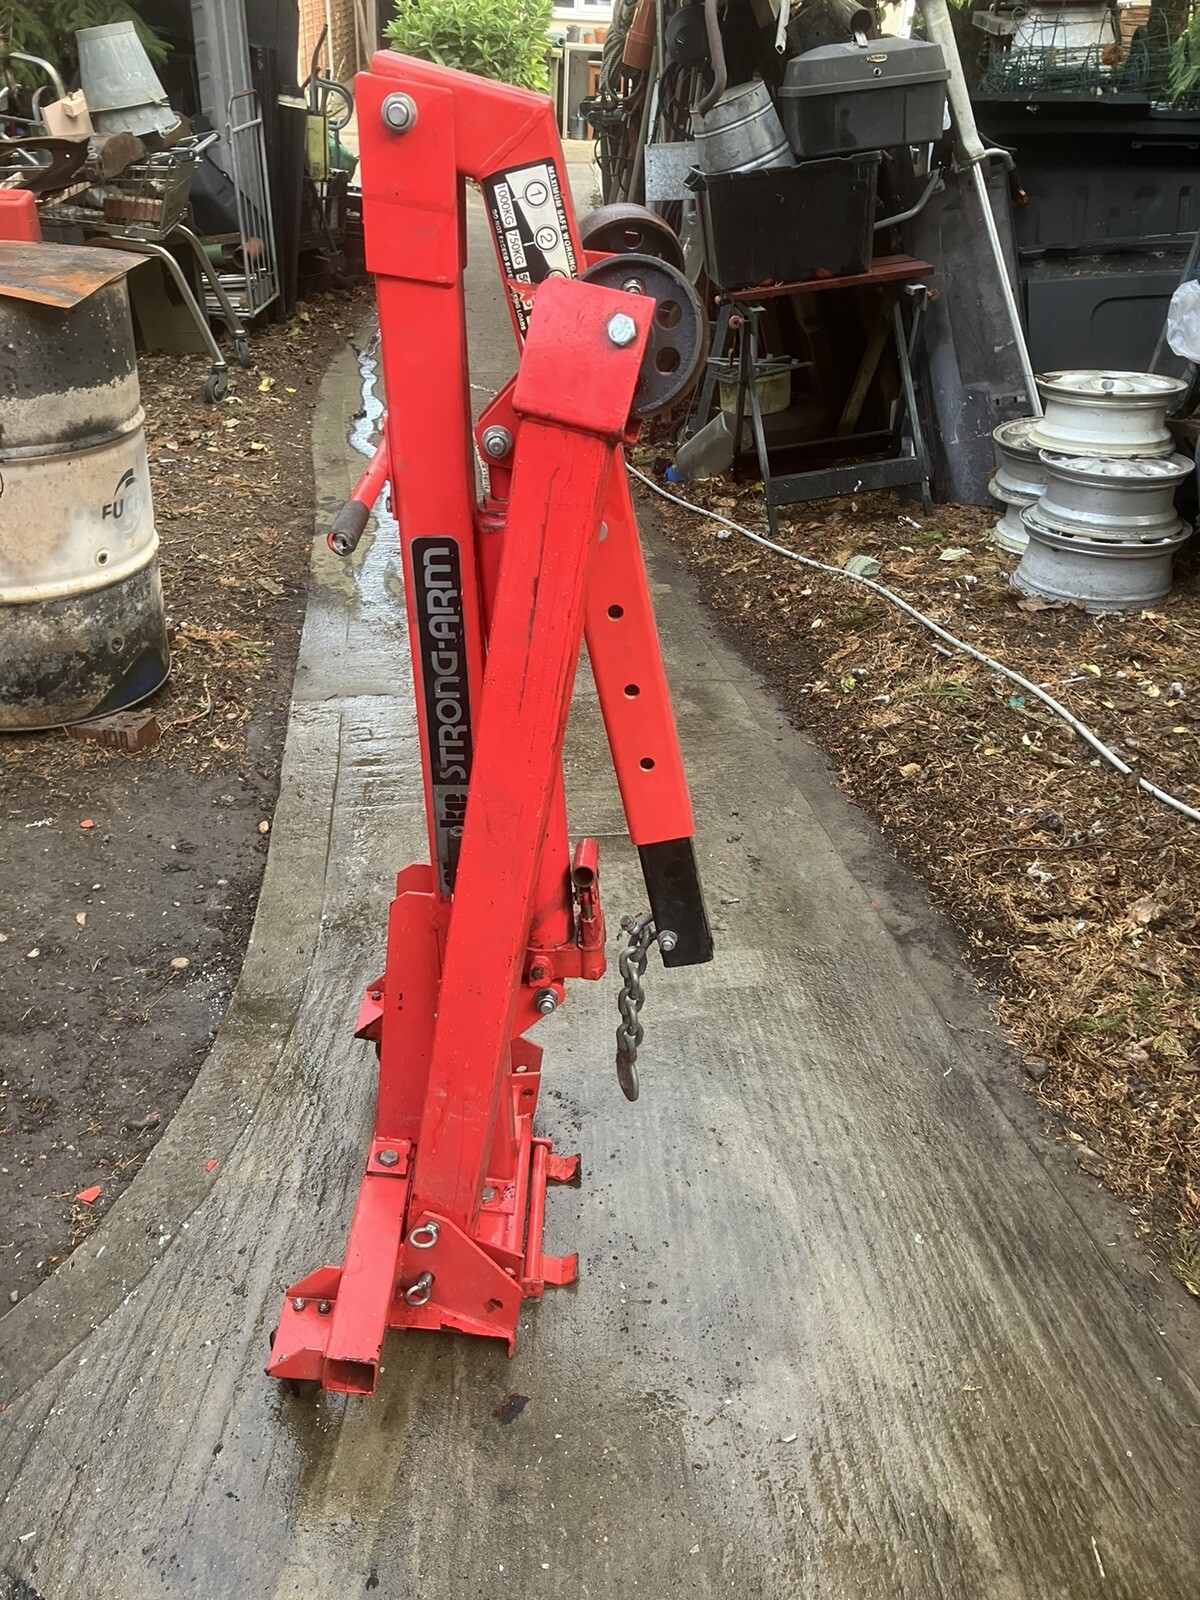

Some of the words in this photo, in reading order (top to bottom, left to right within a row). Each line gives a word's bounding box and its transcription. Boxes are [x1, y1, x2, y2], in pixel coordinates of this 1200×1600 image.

[547, 166, 562, 209] MAXIMUM
[491, 209, 499, 219] DO
[496, 184, 515, 226] 1000KG
[494, 219, 503, 235] NOT
[557, 209, 568, 233] SAFE
[498, 235, 509, 261] EXCEED
[508, 231, 524, 265] 750KG
[540, 233, 554, 245] 2
[562, 233, 577, 271] WORKING
